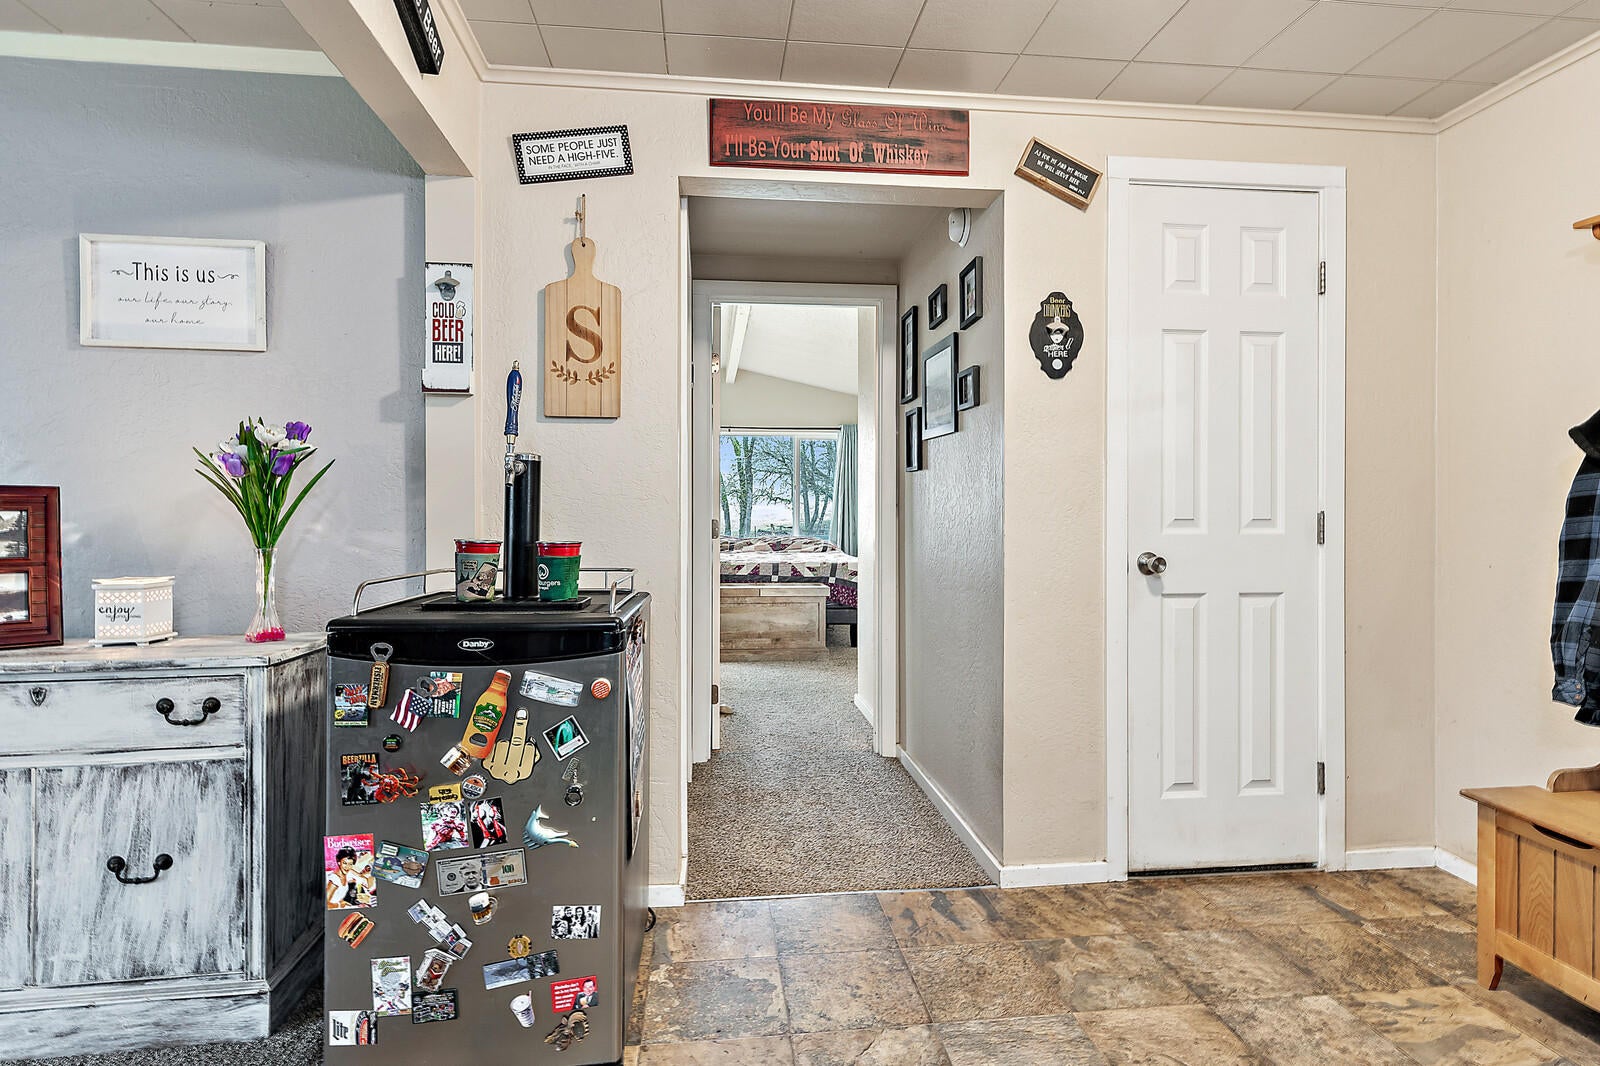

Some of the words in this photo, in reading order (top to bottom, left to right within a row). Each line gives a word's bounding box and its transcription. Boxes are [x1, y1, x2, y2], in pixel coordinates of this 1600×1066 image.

[424, 7, 441, 67] Beer.
[743, 102, 785, 122] You'll
[790, 106, 808, 124] Be
[813, 107, 835, 130] My
[840, 108, 878, 129] Glass
[911, 111, 948, 133] Wine
[526, 143, 555, 155] SOME
[558, 140, 594, 152] PEOPLE
[597, 138, 618, 148] JUST
[725, 134, 743, 157] I'll
[748, 136, 766, 157] Be
[771, 137, 808, 159] Your
[810, 140, 840, 162] Shot
[850, 141, 864, 163] Of
[873, 143, 929, 168] Whiskey
[528, 155, 555, 166] NEED
[558, 154, 566, 163] A
[568, 149, 619, 162] HIGH-FIVE.
[1042, 153, 1051, 161] FOR
[132, 261, 169, 282] This
[175, 265, 189, 282] is
[196, 269, 216, 284] us
[432, 302, 455, 318] COLD
[432, 319, 464, 342] BEER
[566, 305, 603, 364] S
[435, 345, 461, 361] HERE!
[98, 604, 135, 622] enjoy
[462, 640, 490, 648] Danby
[370, 666, 382, 706] FISHERMAN
[342, 754, 377, 765] BEERZILLA
[327, 837, 371, 849] Budweiser
[501, 864, 515, 874] 100
[332, 1019, 349, 1040] Lite
